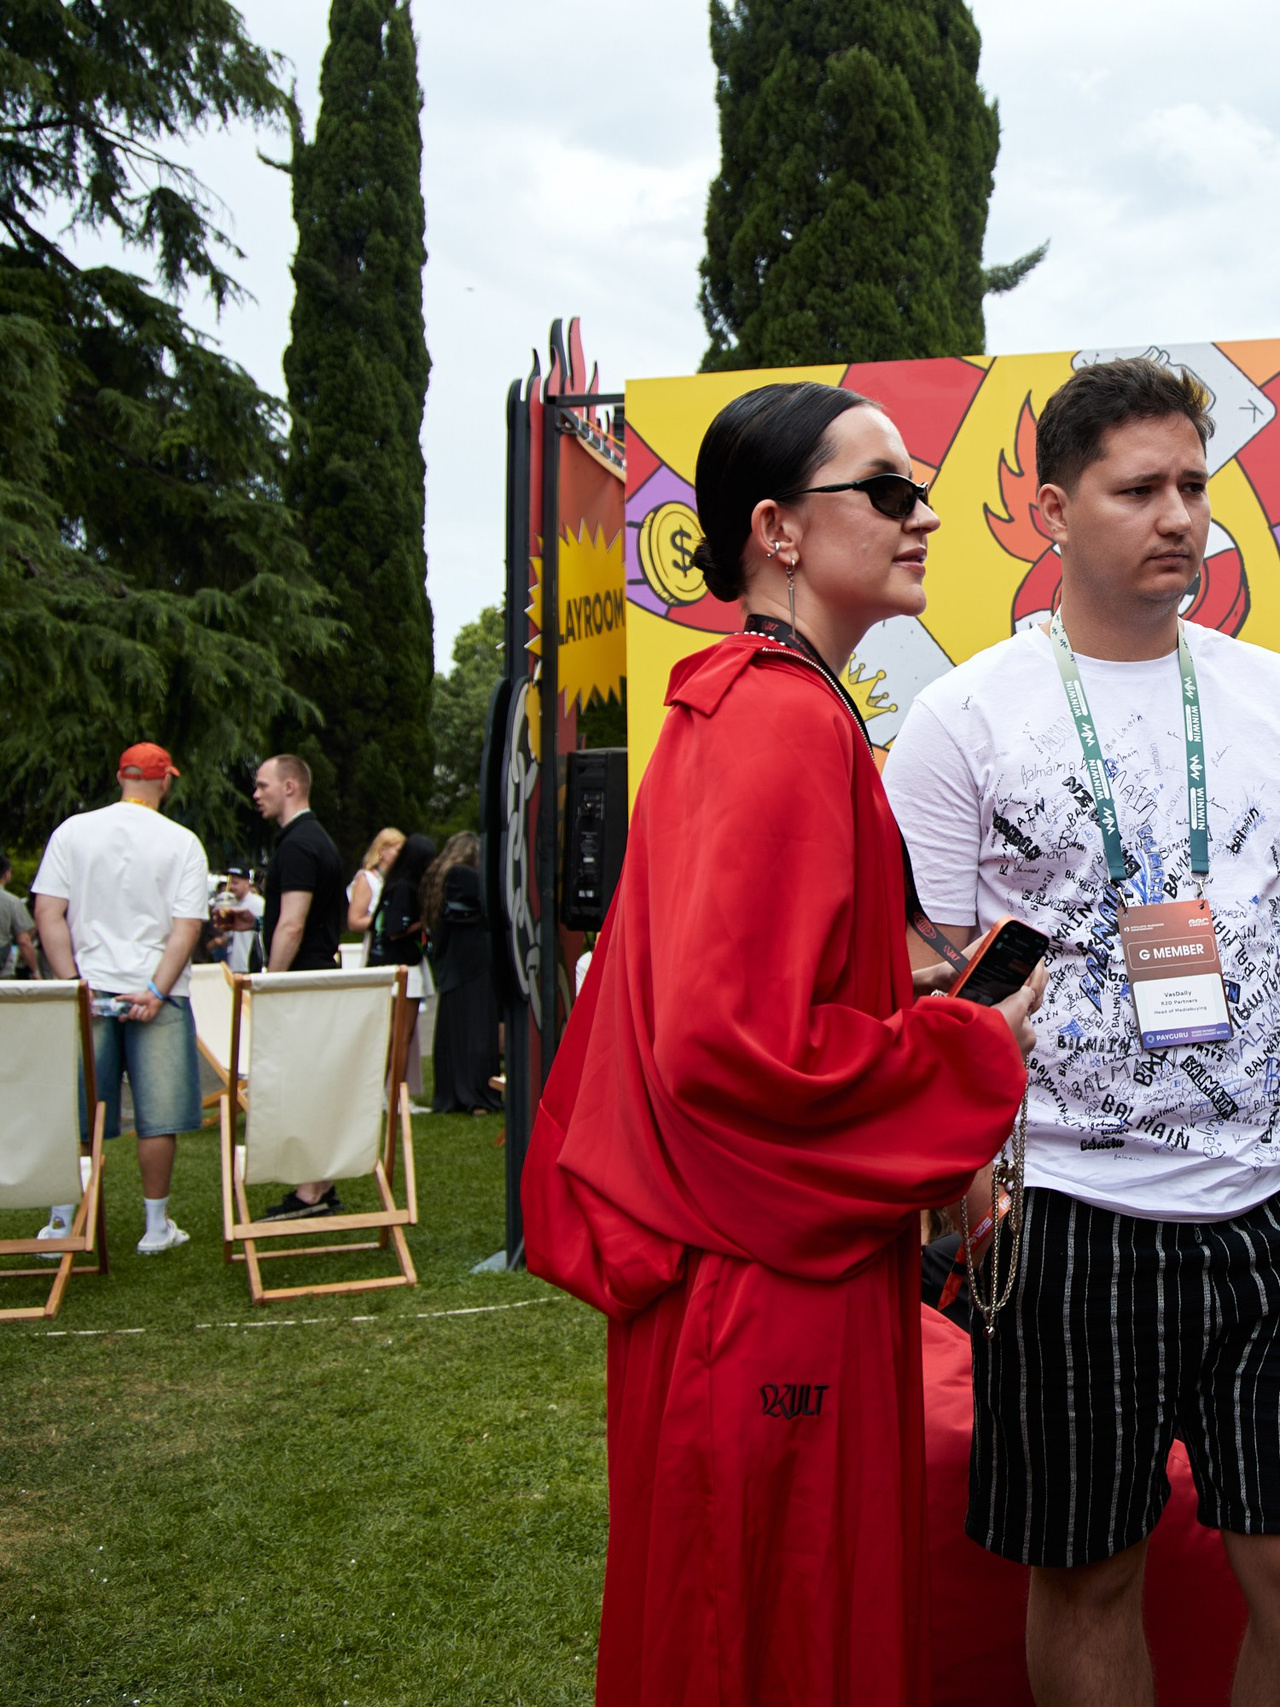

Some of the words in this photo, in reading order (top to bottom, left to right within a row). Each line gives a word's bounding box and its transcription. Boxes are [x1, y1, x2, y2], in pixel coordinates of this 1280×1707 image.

[559, 587, 625, 646] AYROOM
[1066, 681, 1082, 718] WINWIN
[1191, 705, 1202, 743] WINWIN
[1088, 759, 1104, 801] WINWIN
[1196, 787, 1206, 831] WINWIN
[1139, 949, 1150, 960] G
[1153, 943, 1204, 959] MEMBER
[1111, 983, 1121, 1028] BALMAIN
[1156, 1031, 1189, 1041] PAYGURU
